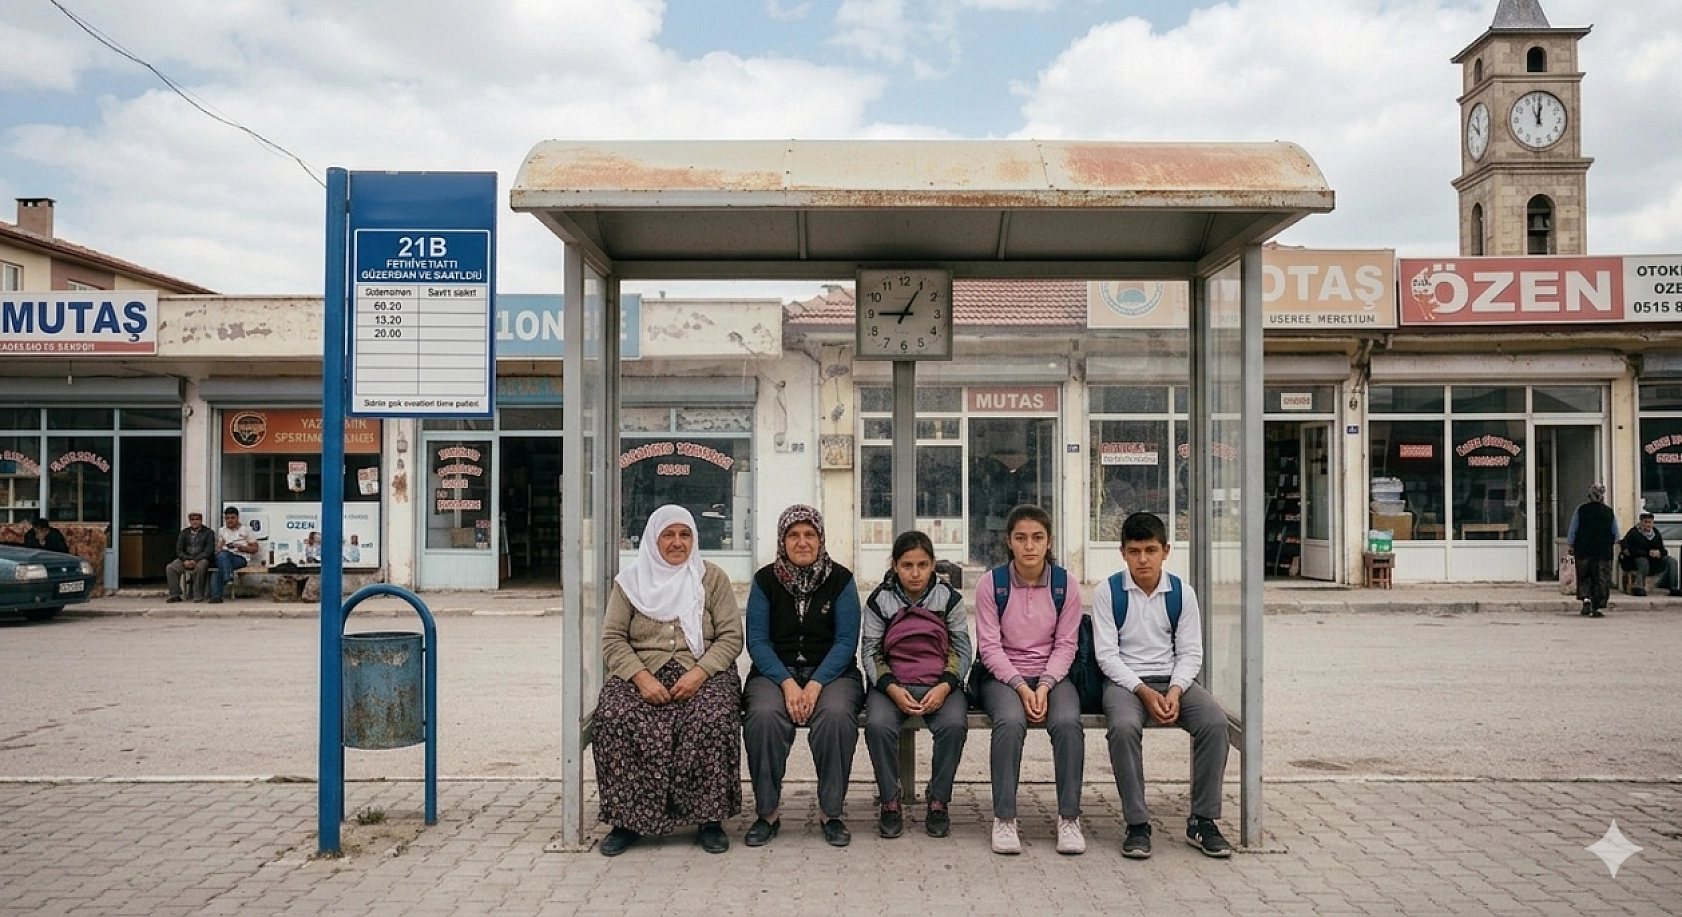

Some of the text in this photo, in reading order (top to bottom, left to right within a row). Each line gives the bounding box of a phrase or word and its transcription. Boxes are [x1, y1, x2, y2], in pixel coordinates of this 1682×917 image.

[398, 237, 447, 257] 21B
[419, 270, 431, 279] VE
[1637, 265, 1682, 277] OTOK
[882, 281, 892, 291] 11
[899, 276, 911, 286] 12
[1428, 263, 1612, 314] ÖZEN
[869, 292, 881, 302] 10
[930, 292, 938, 302] 2
[1633, 301, 1670, 313] 0515
[867, 309, 874, 318] 9
[934, 309, 941, 319] 3
[2, 300, 148, 342] MUTAŞ
[871, 325, 878, 337] 8
[929, 325, 937, 335] 4
[883, 337, 890, 348] 7
[900, 340, 908, 350] 6
[917, 337, 925, 347] 5
[975, 392, 1044, 409] MUTAS
